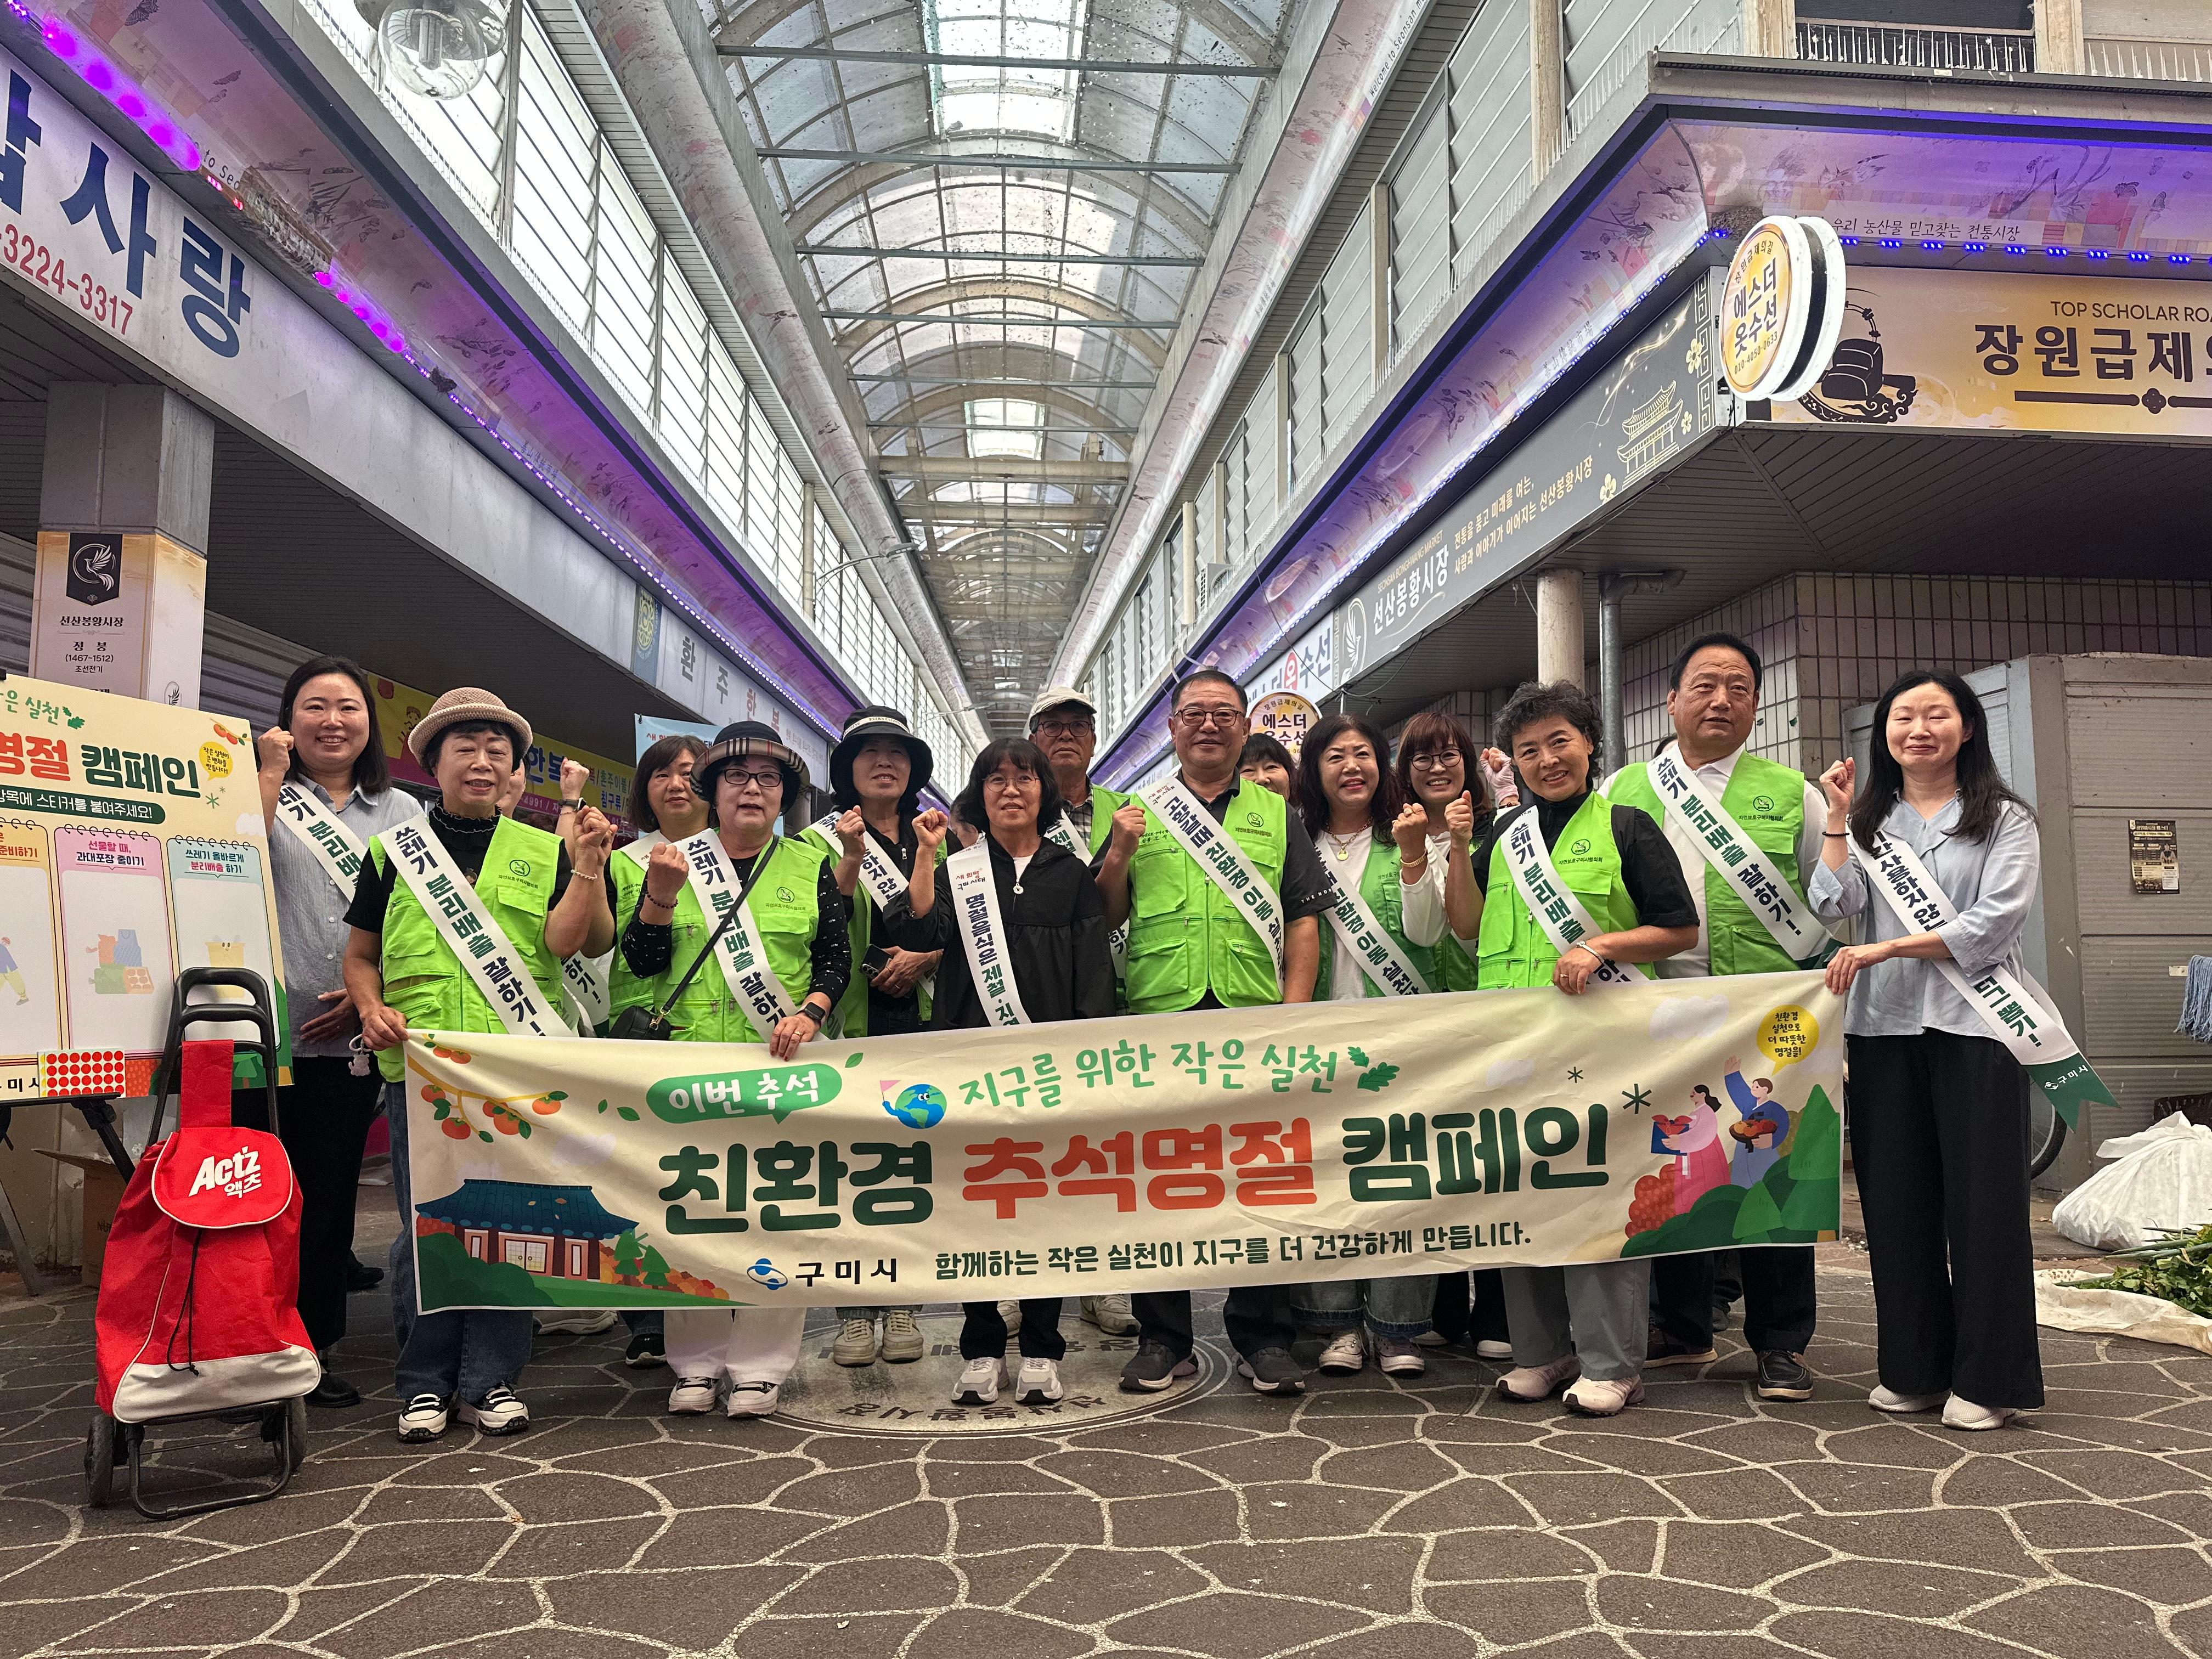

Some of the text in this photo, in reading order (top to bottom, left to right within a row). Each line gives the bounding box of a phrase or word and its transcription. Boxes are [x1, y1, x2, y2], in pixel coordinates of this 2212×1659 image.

[1370, 62, 1390, 97] Welcome
[1388, 51, 1395, 61] to
[1394, 10, 1417, 50] Seonsan
[204, 149, 240, 190] to Seo
[1832, 218, 1857, 233] 우리
[1864, 219, 1903, 235] 농산물
[1910, 222, 1961, 238] 믿고찾는
[0, 224, 133, 336] 3224-3317
[1734, 257, 1776, 318] 에스더
[1735, 293, 1778, 358] 옷수선
[2051, 301, 2212, 323] TOP SCHOLAR RO
[1734, 331, 1778, 374] 010-4050-0633
[1974, 324, 2212, 382] 장원급제
[1454, 475, 1534, 551] 전통을 품고 미래를 여는,
[1454, 454, 1593, 575] 사람과 이야기가 이어지는 선산봉황시장
[1378, 572, 1396, 594] SEONSAN
[1424, 529, 1443, 555] MARKET
[1373, 544, 1449, 635] 선산봉황시장
[59, 616, 124, 628] 선산봉황시장
[75, 664, 103, 674] 조선전기
[0, 690, 59, 725] 은 실천
[1262, 713, 1307, 729] 에스더
[1264, 698, 1304, 711] 장원급제의길
[203, 747, 213, 755] 작은
[81, 744, 201, 798] 캠페인
[36, 794, 87, 812] 스티커를
[90, 799, 153, 819] 붙여주세요!
[88, 840, 116, 852] 선물할
[278, 783, 363, 889] 레기 분리배
[1657, 757, 1802, 936] 쓰레기 분리배출 잘하기!
[76, 851, 144, 866] 과대포장 줄이기
[185, 849, 244, 863] 쓰레기 올바르게
[190, 861, 242, 874] 분리배출 하기
[687, 839, 725, 885] 쓰레기
[966, 871, 980, 879] 희망
[395, 826, 438, 874] 쓰레기
[426, 873, 496, 960] 분리배출
[957, 881, 969, 891] 구미
[1205, 841, 1250, 890] 친환경
[1243, 885, 1274, 921] 이동
[1301, 888, 1333, 904] THE NOR
[1510, 823, 1585, 945] 쓰레기 분리배출
[1880, 854, 1928, 908] 사용하지
[966, 893, 998, 966] 명절음식은
[1357, 930, 1389, 966] 이동
[1772, 1023, 1802, 1034] 실천으로
[1775, 1011, 1798, 1022] 친환경
[1768, 1034, 1807, 1046] 더 따뜻한
[1775, 1046, 1802, 1058] 명절을!
[668, 1070, 820, 1114] 이번 추석
[958, 1039, 1337, 1108] 지구를 위한 작은 실천
[2057, 1064, 2089, 1084] 구미시
[224, 1172, 262, 1198] 액츠
[658, 1103, 1610, 1235] 친환경 추석명절 캠페인
[936, 1221, 1531, 1280] 함께하는 작은 실천이 지구를 더 건강하게 만듭니다.
[795, 1258, 898, 1288] 구미시
